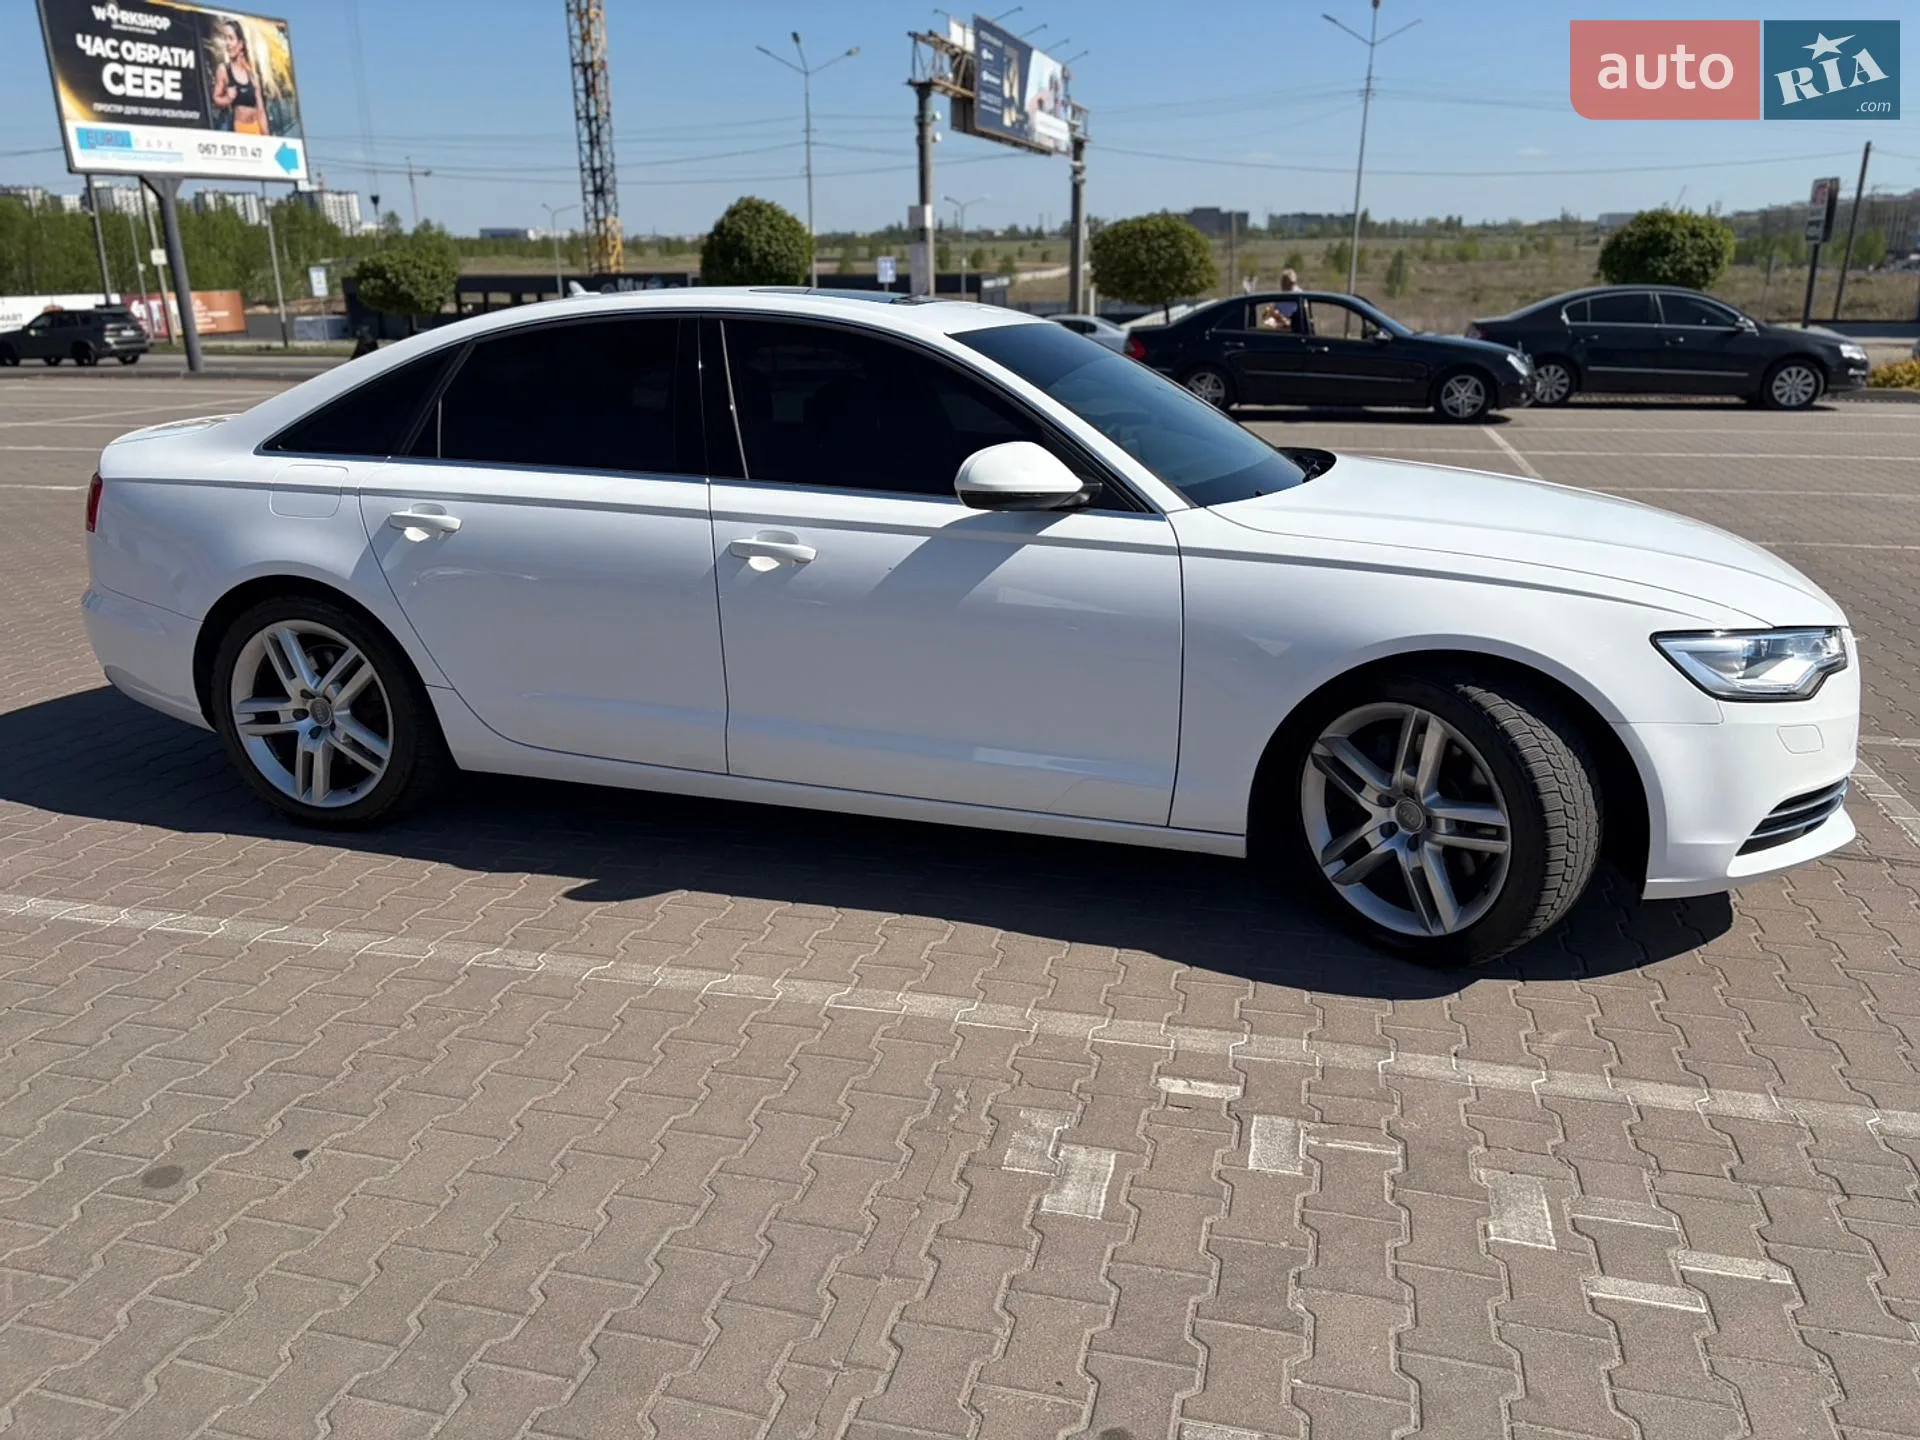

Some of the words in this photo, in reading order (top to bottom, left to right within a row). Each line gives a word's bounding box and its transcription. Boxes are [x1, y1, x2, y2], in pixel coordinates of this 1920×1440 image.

[91, 3, 171, 31] WORKSHOP
[75, 33, 119, 59] ЧАС
[120, 40, 195, 69] ОБРАТИ
[102, 62, 183, 101] СЕБЕ
[198, 142, 217, 154] 067
[220, 144, 236, 156] 577
[239, 145, 248, 157] 11
[251, 147, 262, 158] 47
